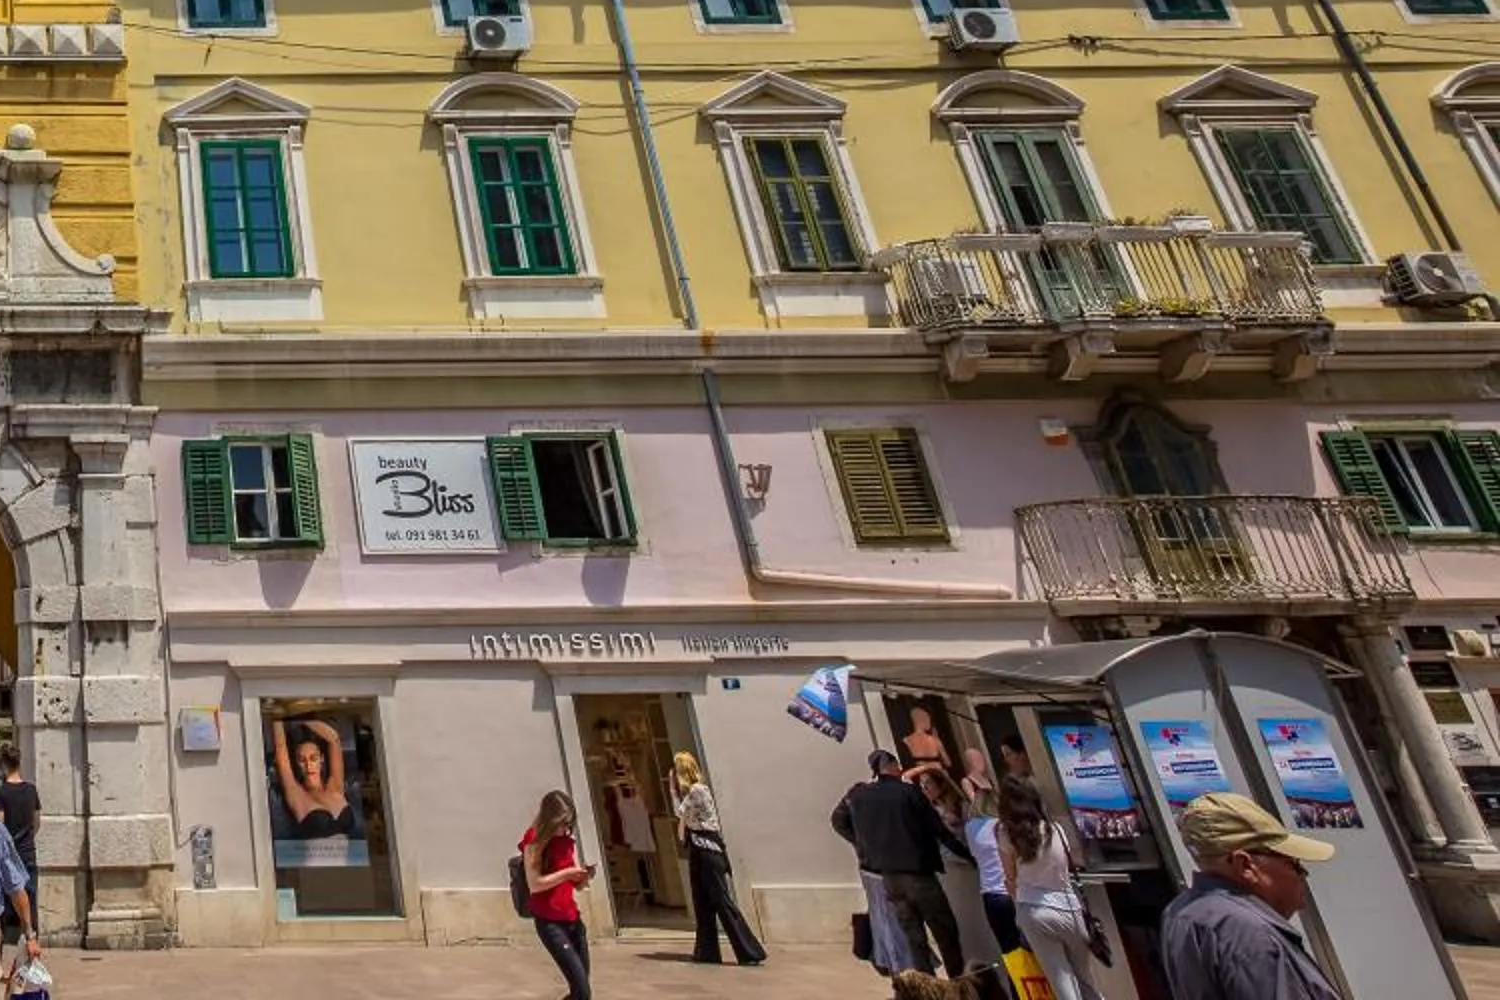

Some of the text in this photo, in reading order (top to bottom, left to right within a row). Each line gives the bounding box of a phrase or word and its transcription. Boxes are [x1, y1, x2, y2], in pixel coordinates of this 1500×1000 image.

[377, 455, 428, 470] beauty
[375, 470, 475, 518] Bliss
[405, 529, 426, 541] 091
[428, 529, 448, 541] 981
[451, 529, 465, 541] 34
[469, 631, 656, 653] intimissimi
